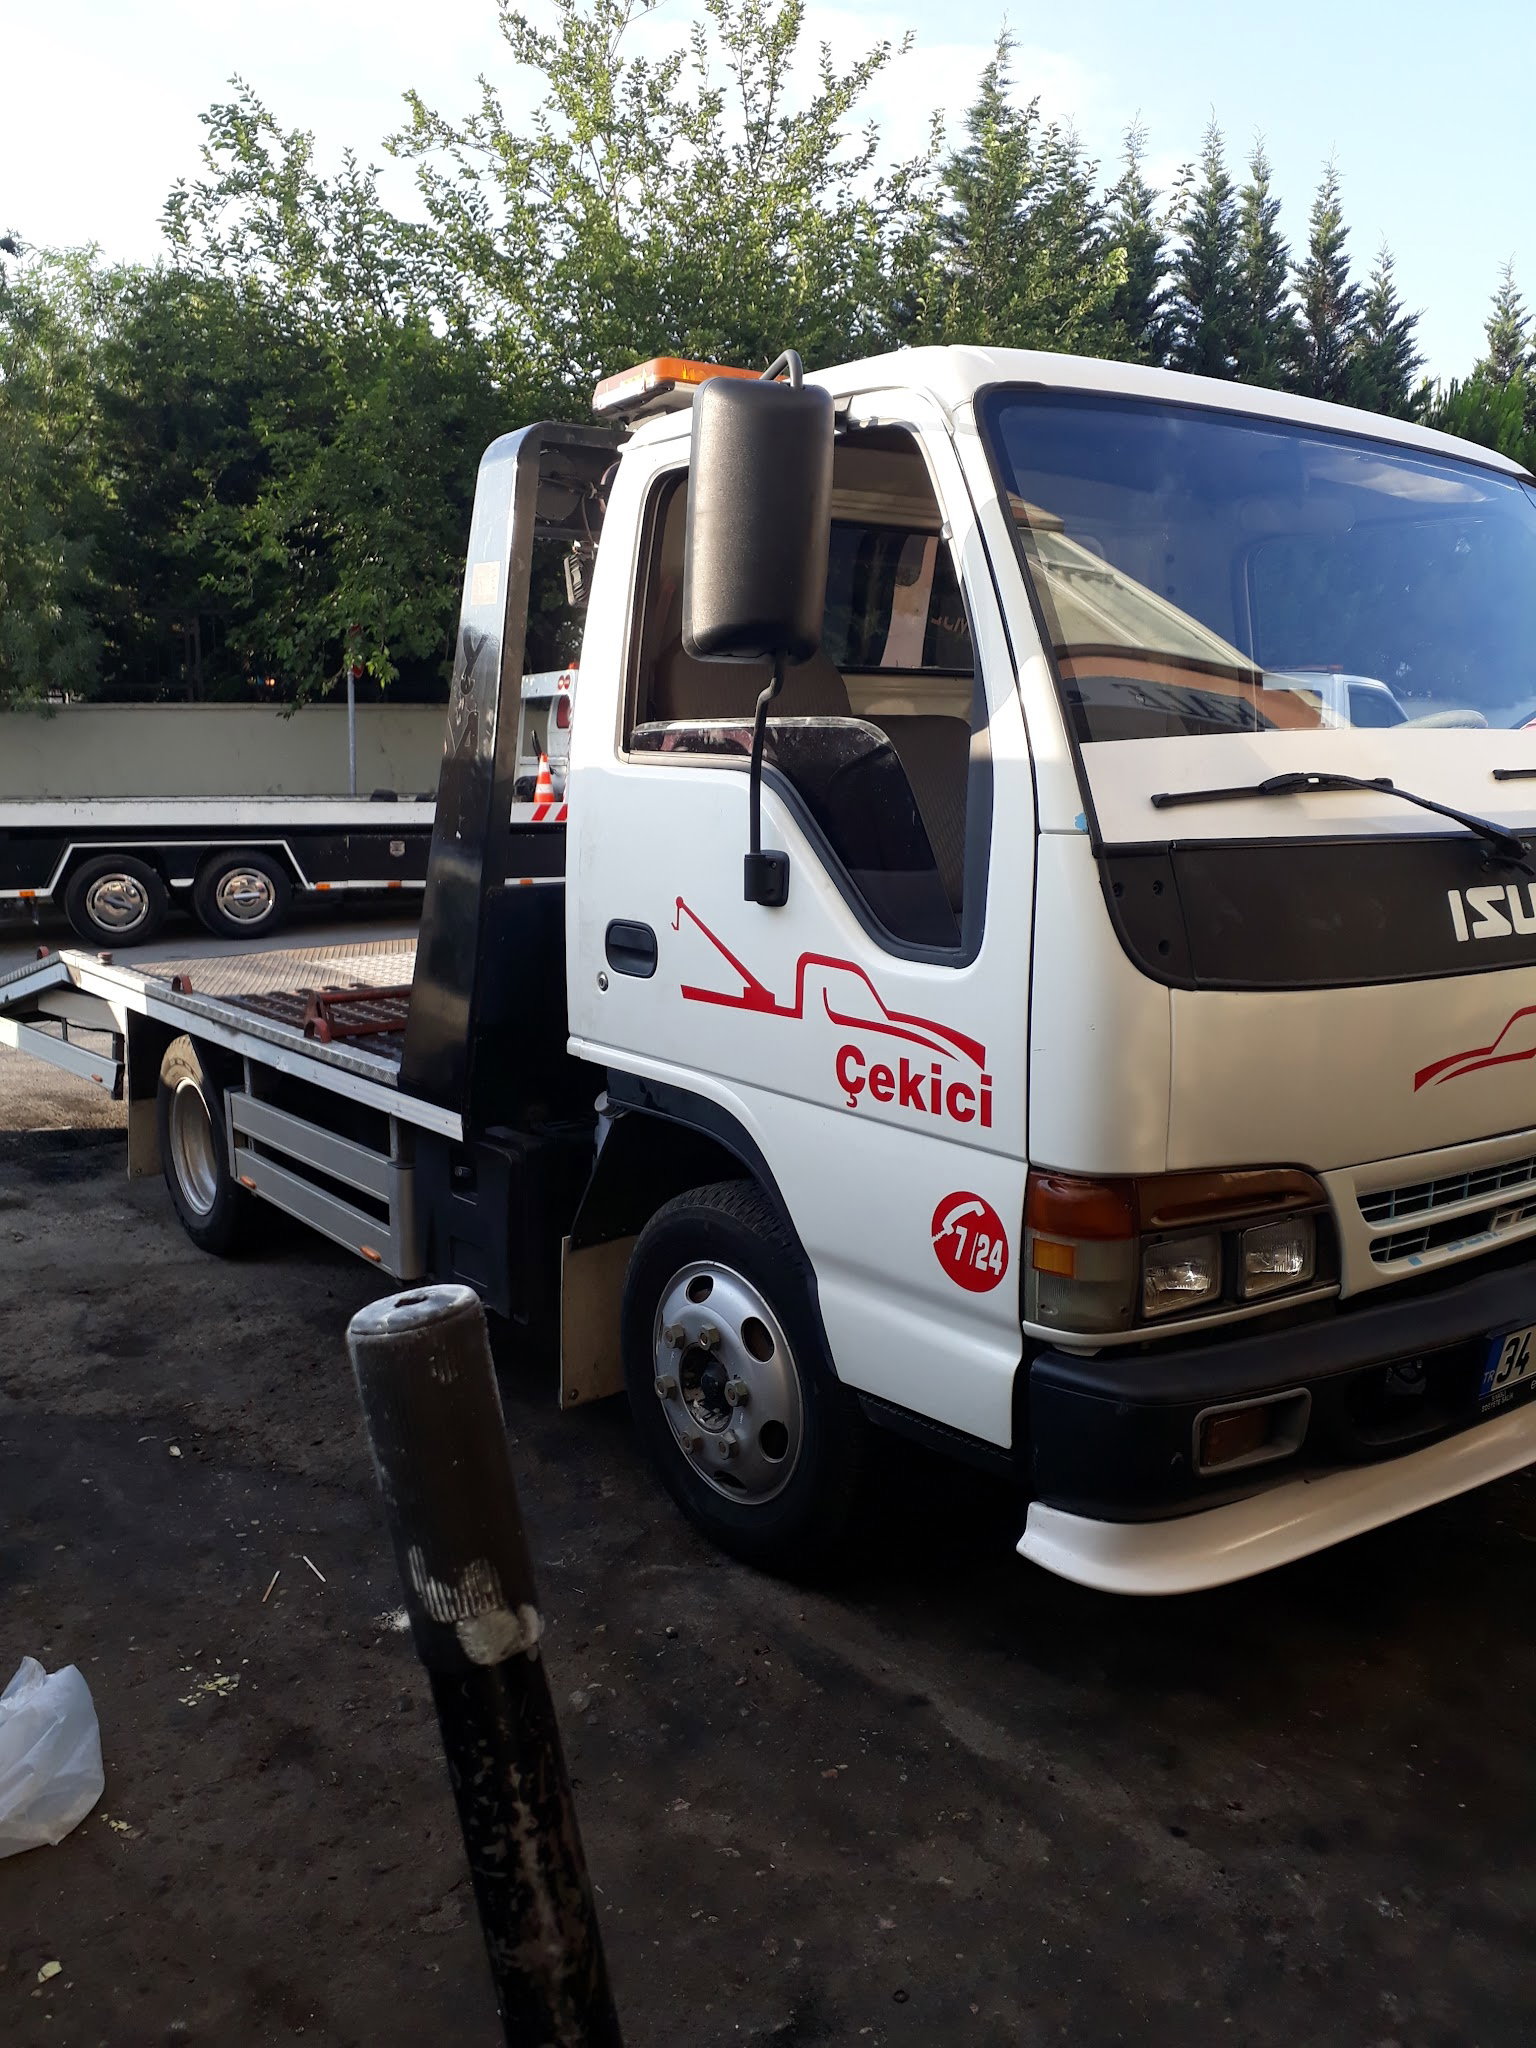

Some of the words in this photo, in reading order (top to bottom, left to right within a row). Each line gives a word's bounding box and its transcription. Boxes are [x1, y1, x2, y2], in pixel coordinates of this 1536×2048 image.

[835, 1044, 993, 1128] Çekici
[954, 1225, 1003, 1276] 7/24
[1483, 1369, 1496, 1384] TR
[1496, 1331, 1532, 1383] 34
